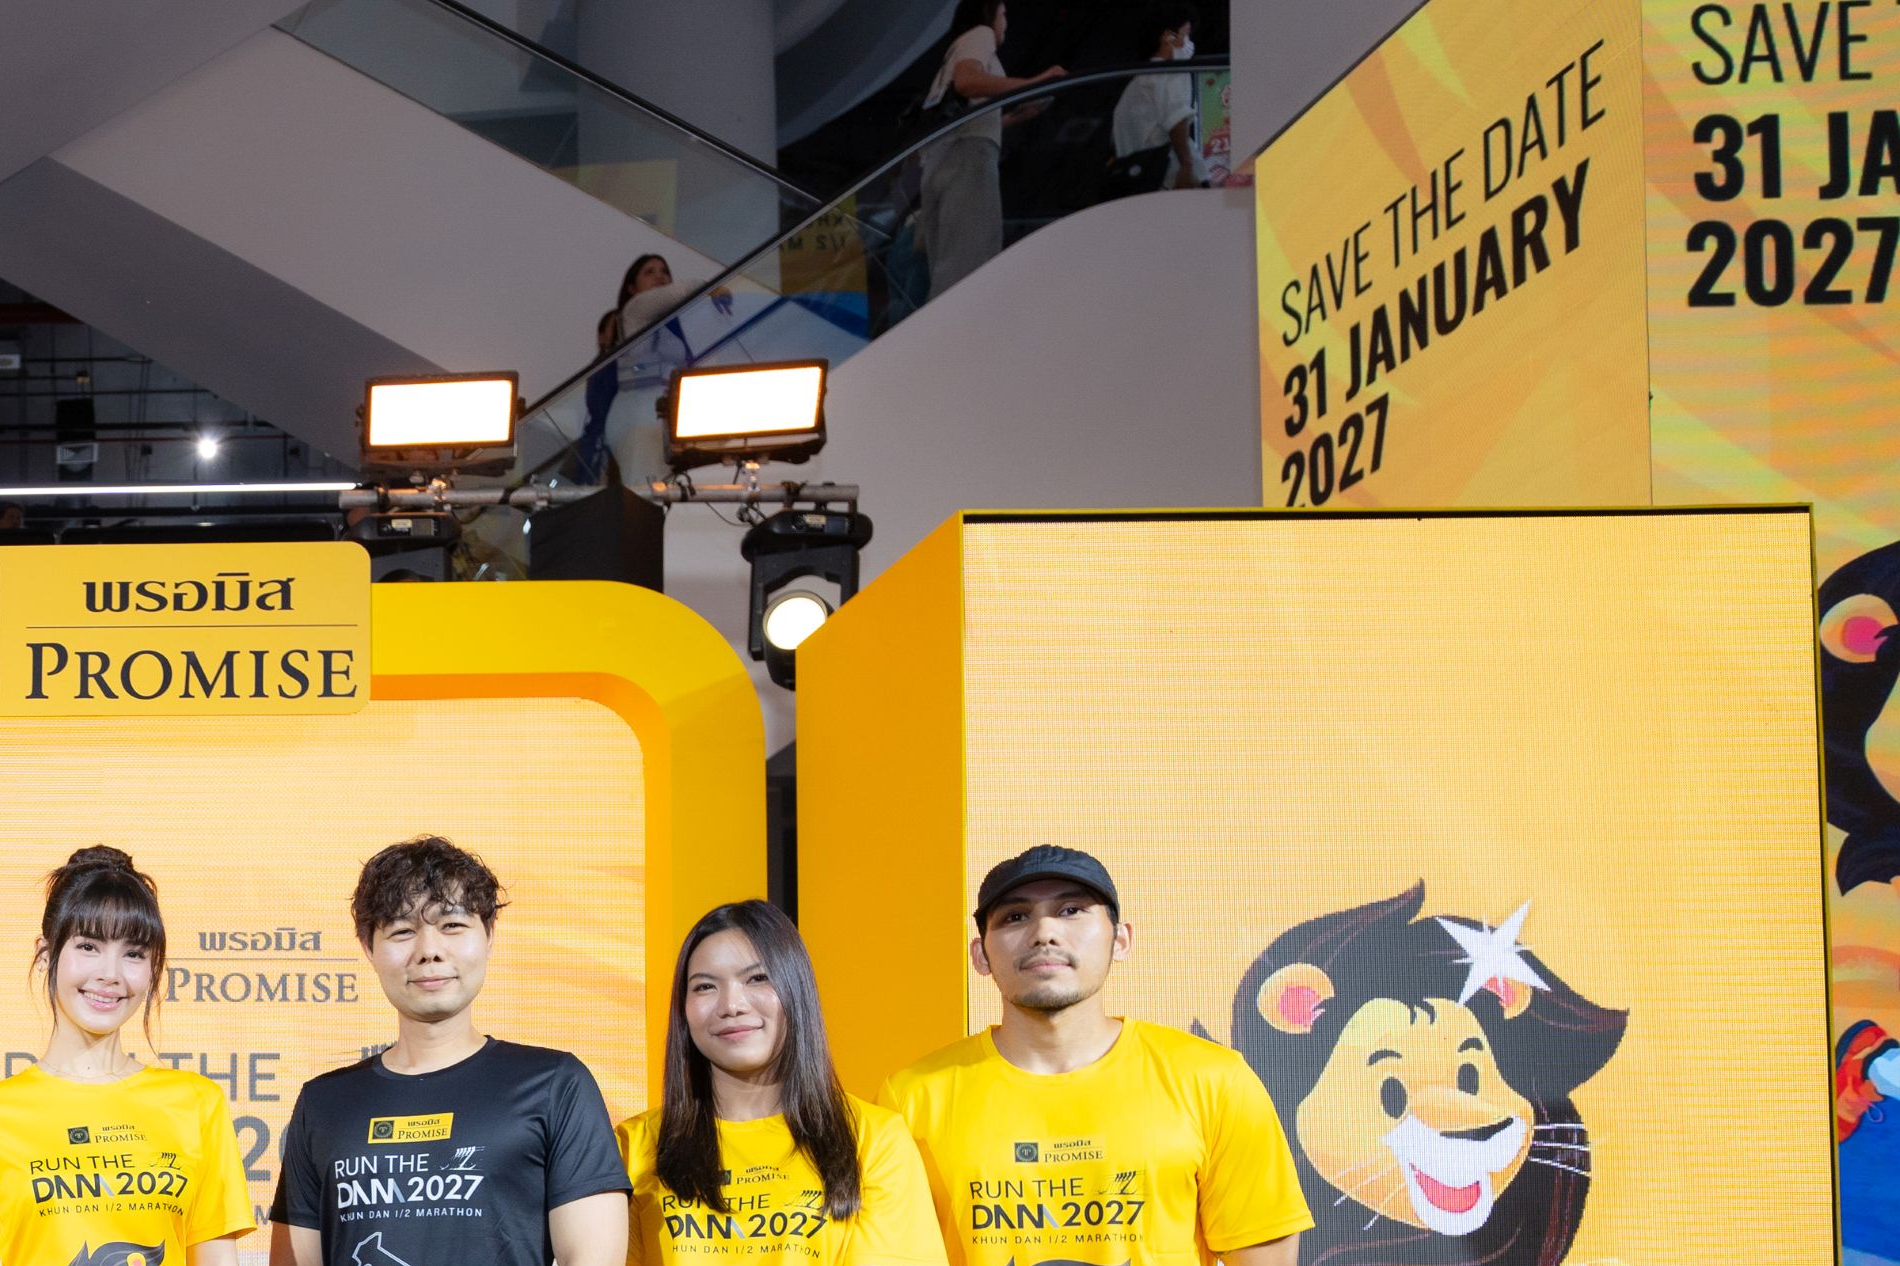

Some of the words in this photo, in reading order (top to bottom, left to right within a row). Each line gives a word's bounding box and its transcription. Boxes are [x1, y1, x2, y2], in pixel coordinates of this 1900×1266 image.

[1690, 1, 1872, 85] SAVE
[1692, 113, 1782, 202] 31
[1281, 221, 1373, 348] SAVE
[1384, 148, 1466, 269] THE
[1483, 38, 1606, 203] DATE
[1686, 215, 1900, 308] 2027
[1284, 346, 1327, 438] 31
[1345, 157, 1590, 403] JANUARY
[1281, 391, 1389, 507] 2027
[83, 572, 296, 613] พรอมิส
[25, 642, 358, 701] PROMISE
[198, 927, 322, 951] พรอมิส
[165, 967, 359, 1003] PROMISE
[30, 1156, 81, 1175] RUN
[87, 1153, 136, 1170] THE
[334, 1155, 378, 1180] RUN
[384, 1153, 430, 1174] THE
[116, 1171, 189, 1199] 2027
[406, 1174, 484, 1202] 2027
[969, 1179, 1023, 1200] RUN
[1032, 1177, 1085, 1198] THE
[39, 1206, 70, 1218] KHUN
[75, 1204, 100, 1214] DAN
[105, 1203, 122, 1212] 1/2
[369, 1209, 390, 1219] DAN
[395, 1208, 411, 1219] 1/2
[416, 1207, 483, 1218] MARATHON
[1061, 1200, 1146, 1227] 2027
[748, 1212, 828, 1239] 2027
[672, 1244, 697, 1253] HUN
[703, 1245, 729, 1254] DAN
[735, 1245, 753, 1254] 1/2
[972, 1235, 1008, 1245] KHUN
[1014, 1235, 1042, 1244] DAN
[1049, 1235, 1068, 1244] 1/2
